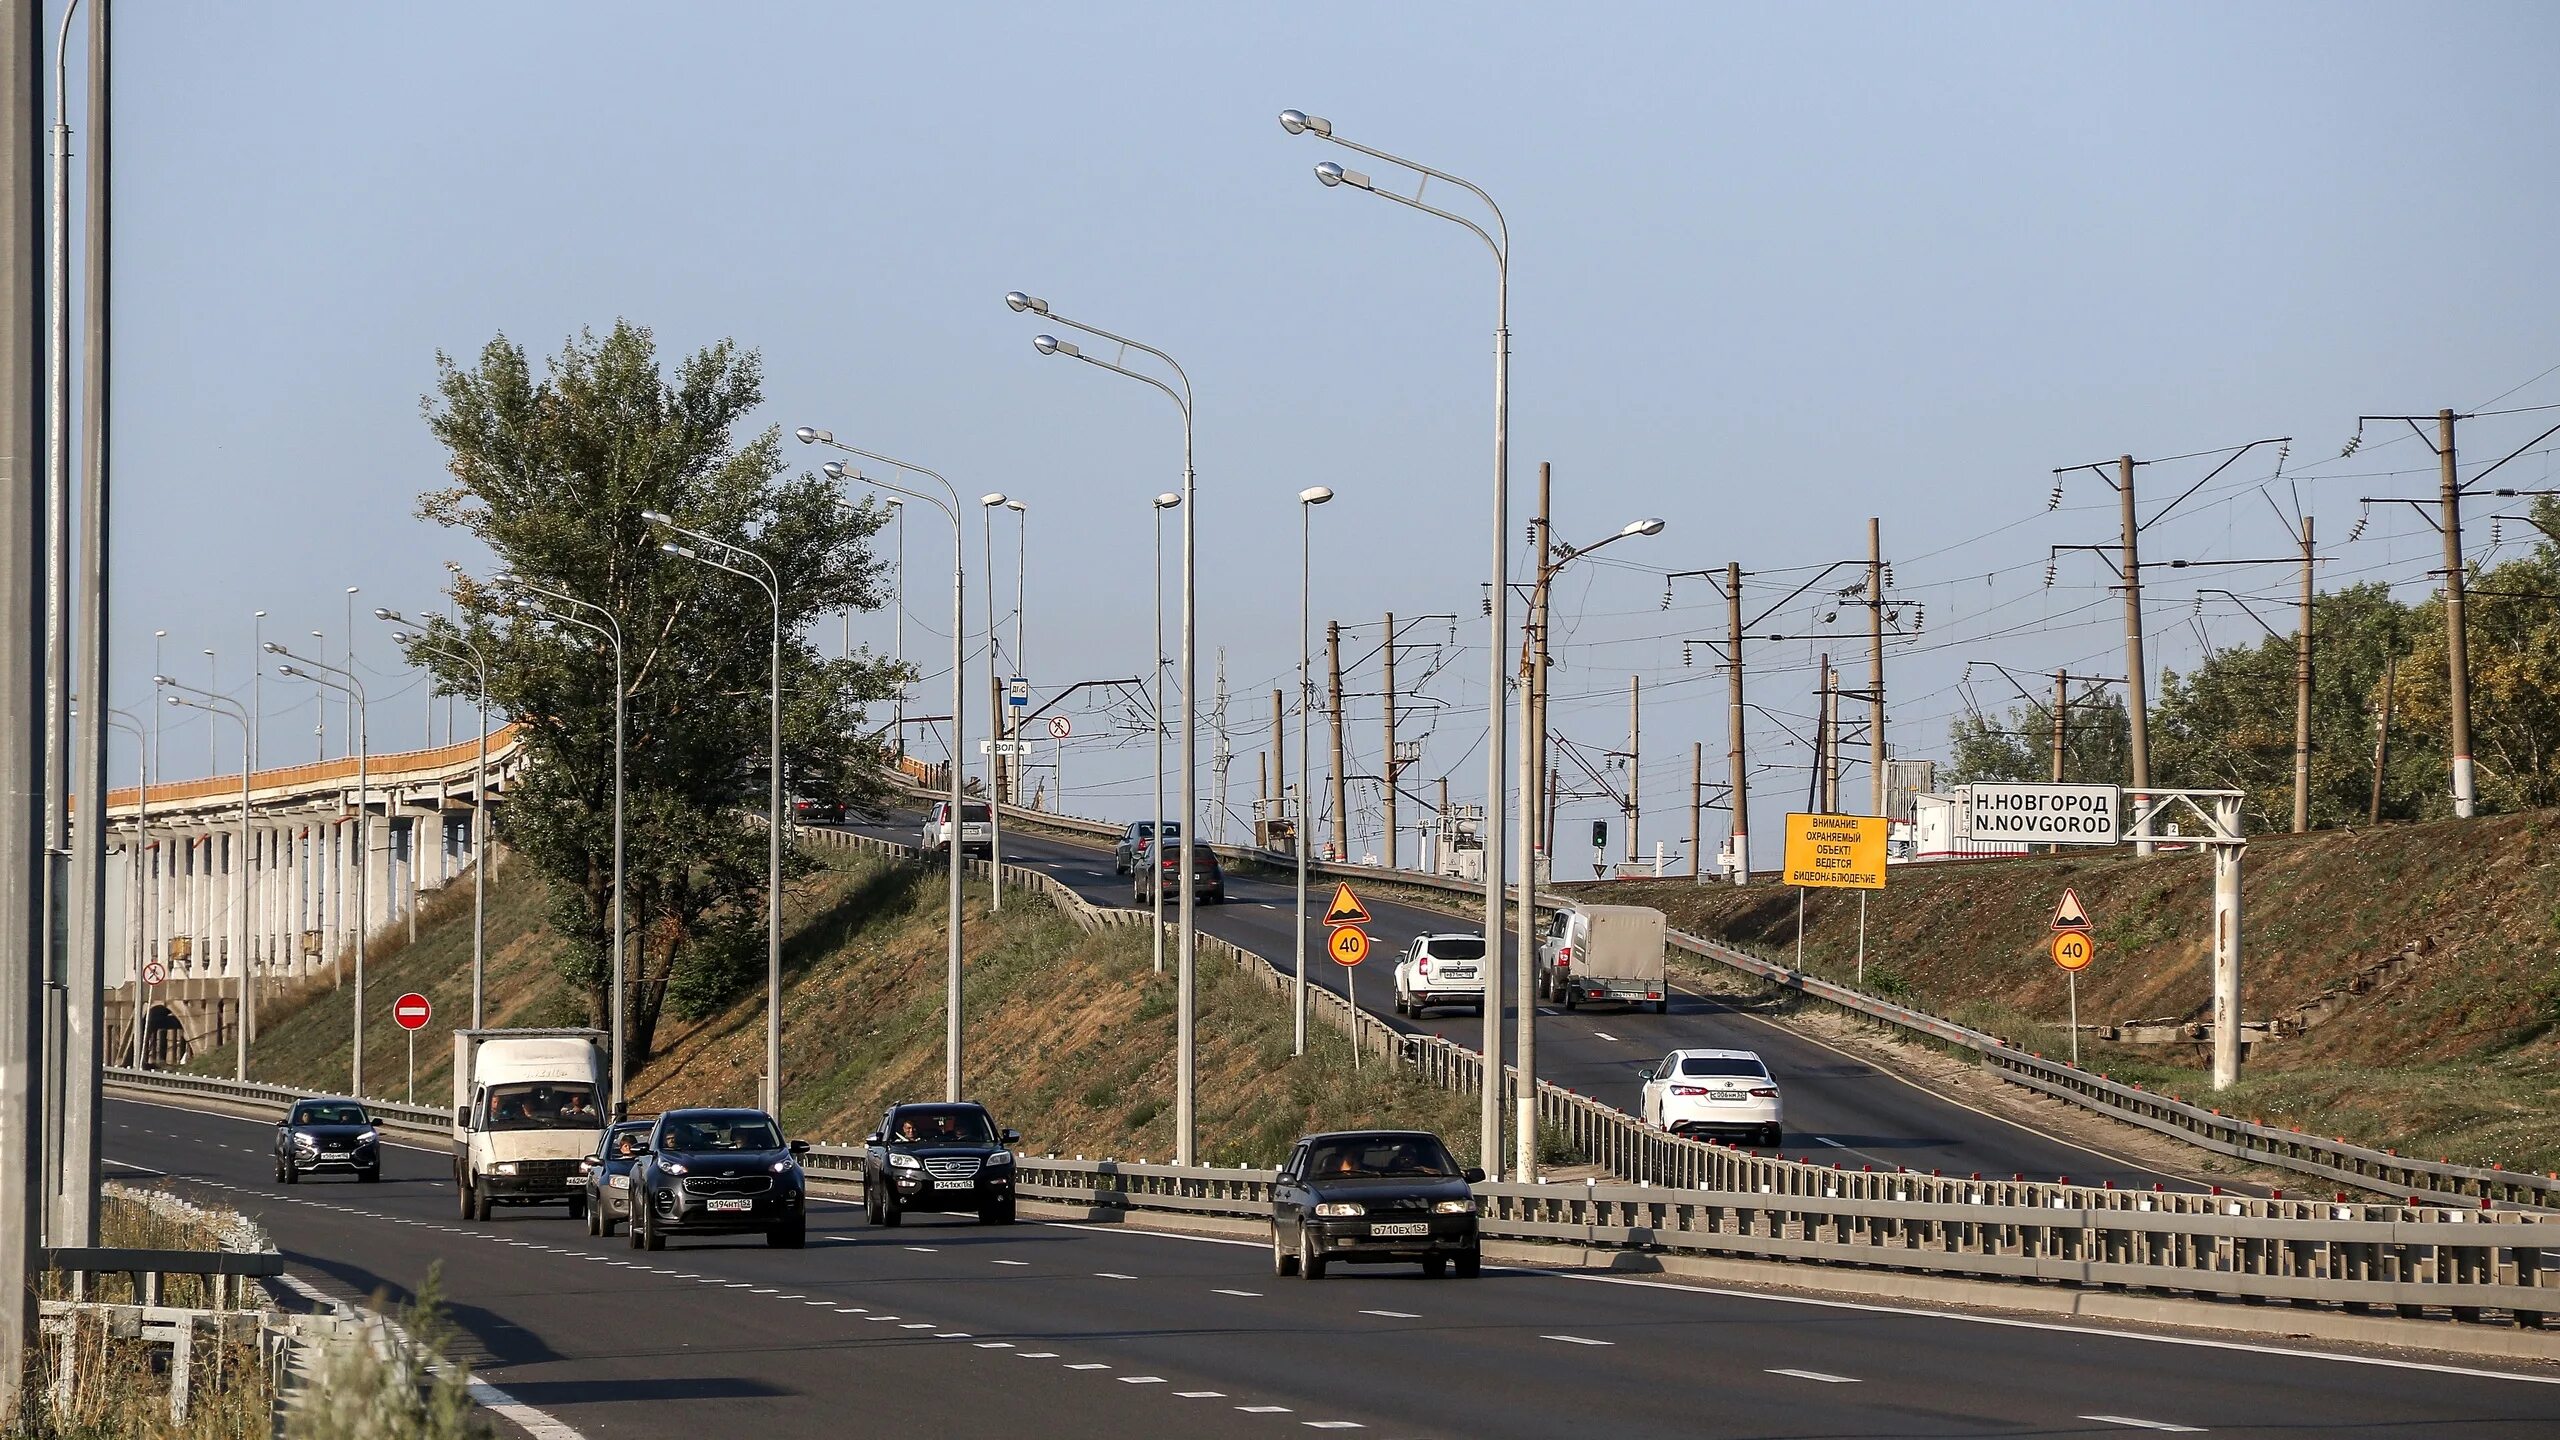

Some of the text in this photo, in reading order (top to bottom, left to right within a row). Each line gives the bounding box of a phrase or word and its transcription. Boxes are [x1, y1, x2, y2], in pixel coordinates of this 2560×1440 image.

[995, 743, 1025, 752] ВОЛА
[1976, 794, 2108, 814] Н.НОВГОРОД
[1812, 818, 1858, 829] ВНИМАНИЕ!
[1976, 815, 2111, 833] N.NOVGOROD
[2171, 824, 2177, 833] 2
[1806, 831, 1861, 843] ОХРАНЯЕМЫЙ
[1816, 844, 1851, 855] ОБЪЕКТ!
[1815, 857, 1852, 869] ВЕДЕТСЯ
[1339, 936, 1360, 953] 40
[2061, 943, 2083, 958] 40
